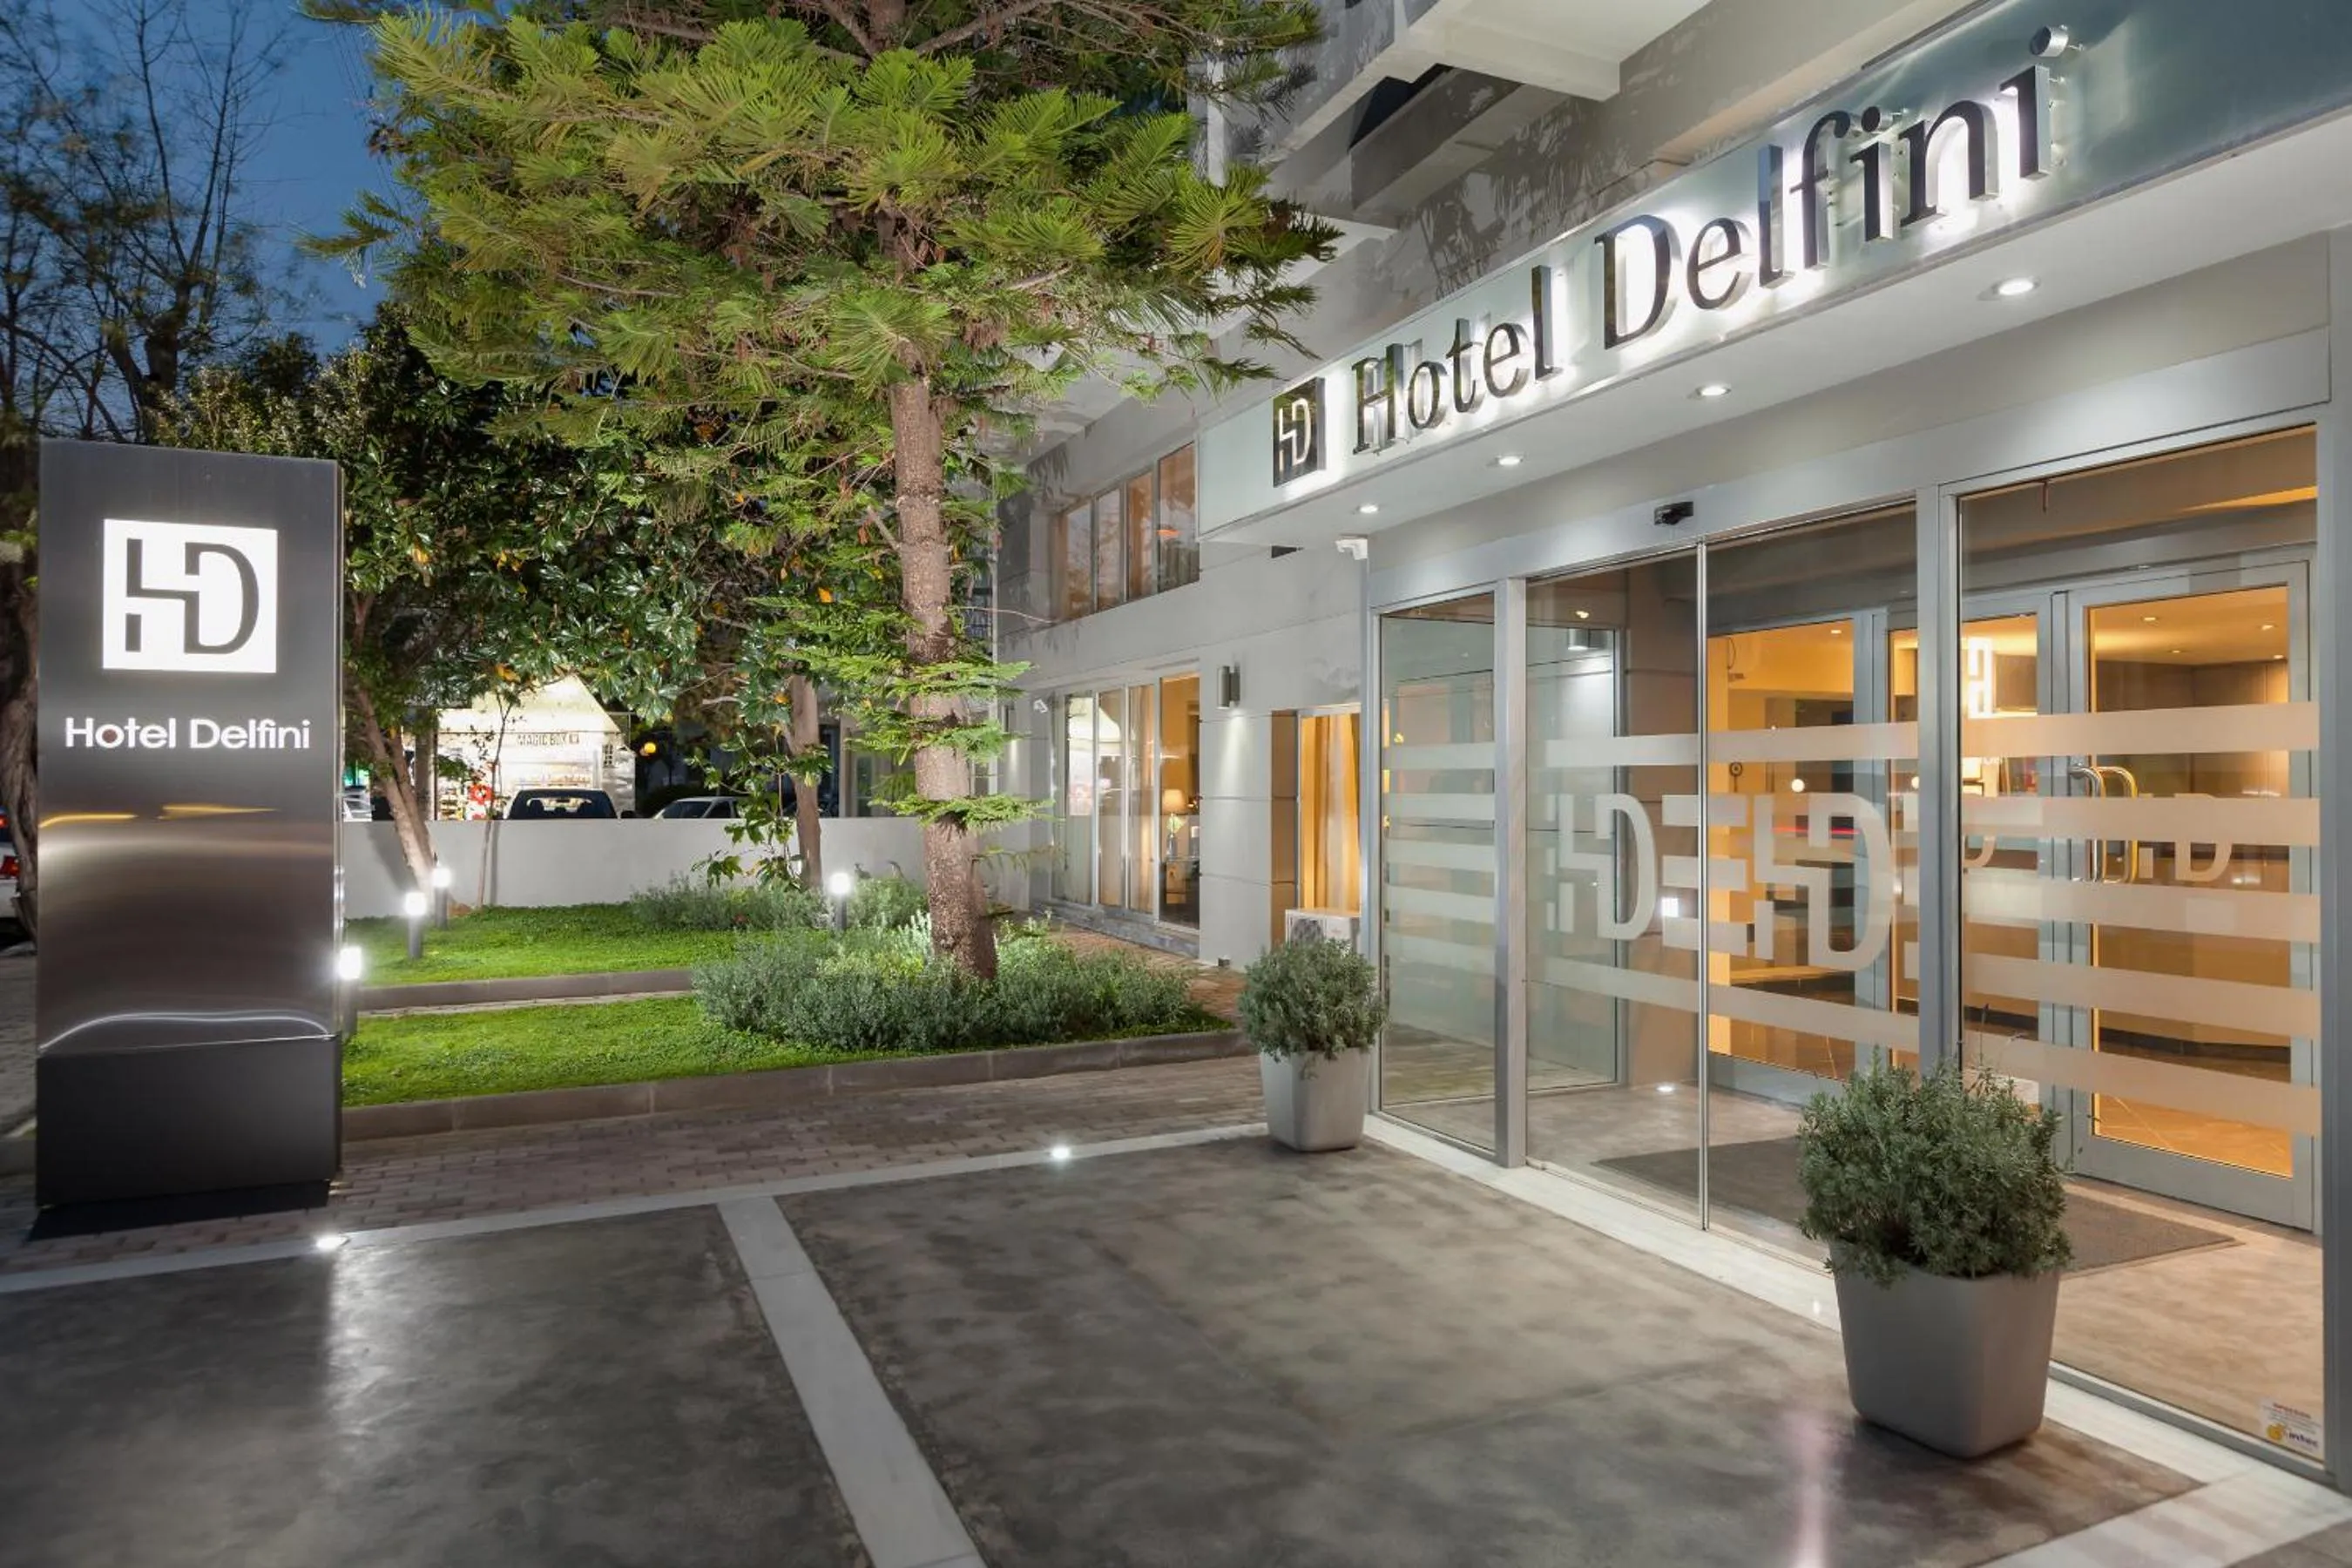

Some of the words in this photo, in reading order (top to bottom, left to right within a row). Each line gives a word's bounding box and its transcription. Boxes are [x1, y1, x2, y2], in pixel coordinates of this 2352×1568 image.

[1352, 265, 1563, 455] Hotel
[1594, 26, 2070, 349] Delfini
[65, 717, 177, 748] Hotel
[190, 718, 311, 749] Delfini
